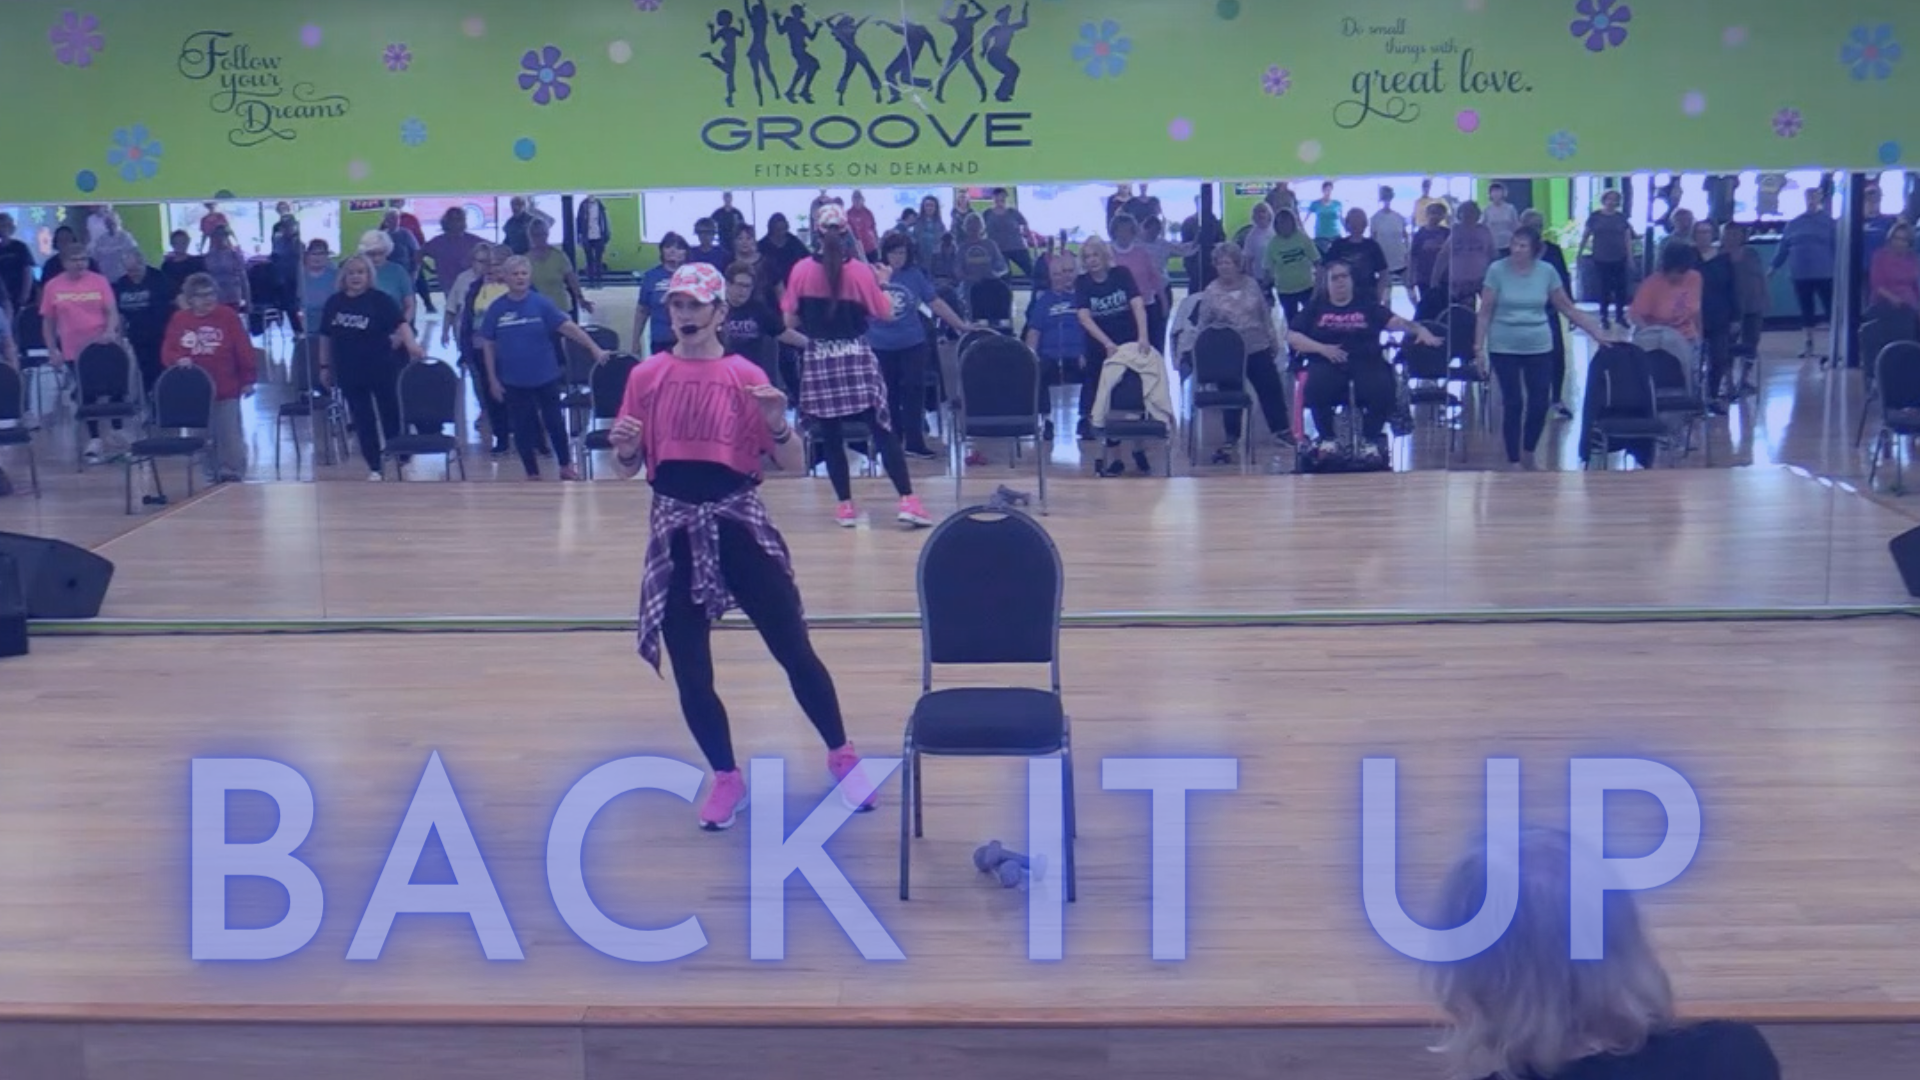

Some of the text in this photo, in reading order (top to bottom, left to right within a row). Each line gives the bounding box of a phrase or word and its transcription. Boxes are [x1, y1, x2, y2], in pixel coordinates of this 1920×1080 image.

[1341, 17, 1407, 37] Do small
[178, 30, 282, 79] Follow
[1385, 37, 1427, 63] things
[210, 72, 283, 113] your
[1333, 48, 1534, 129] great love.
[228, 82, 350, 146] Dreams
[701, 112, 1032, 151] GROOVE
[755, 160, 979, 178] FITNESS ON DEMAND
